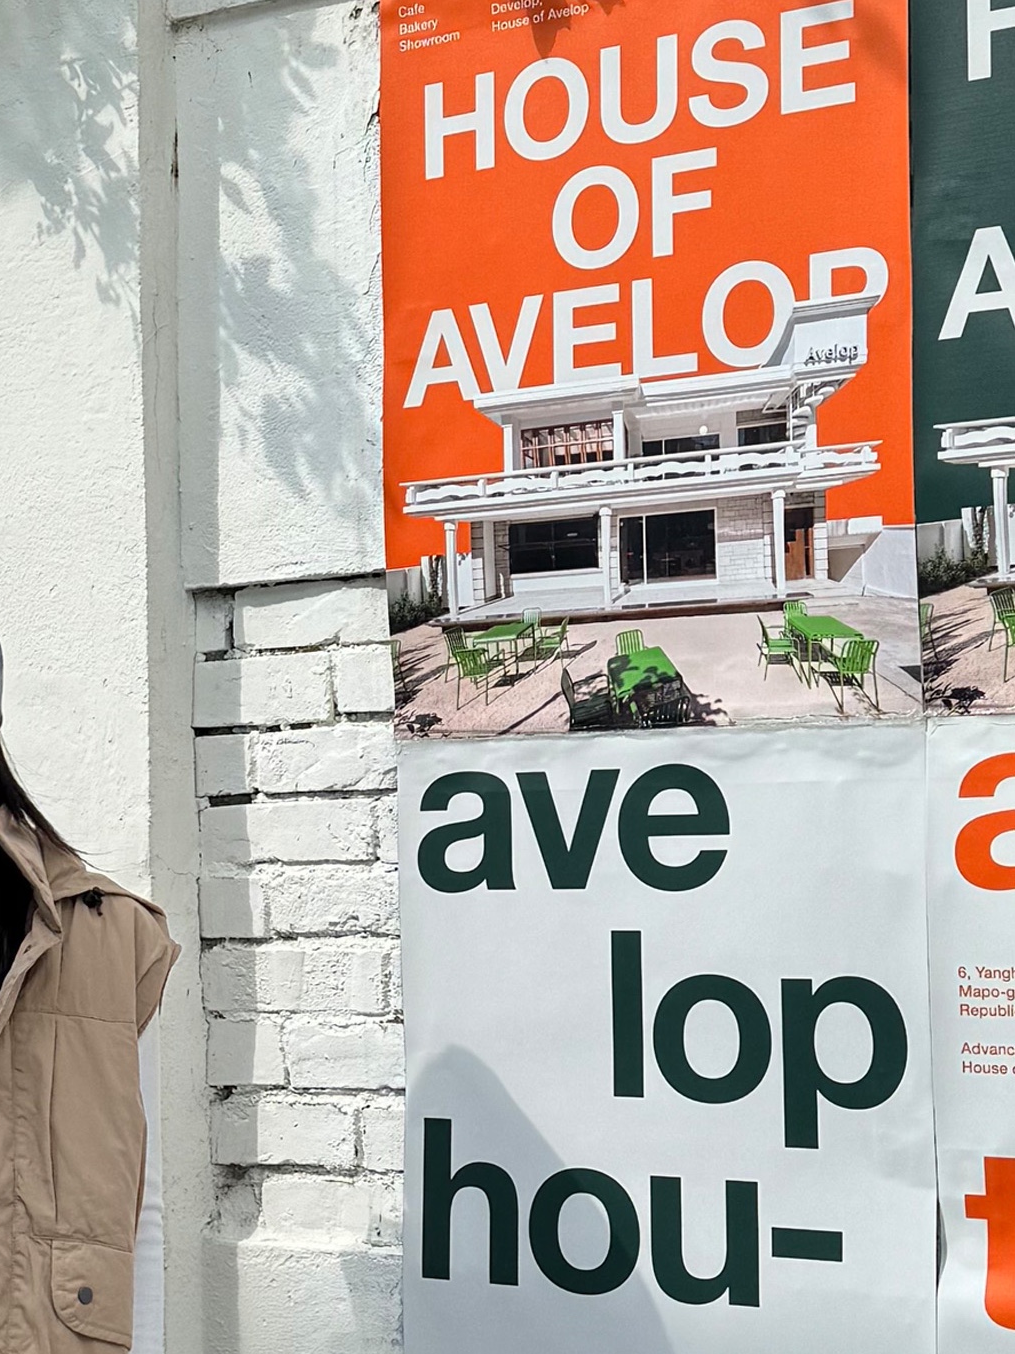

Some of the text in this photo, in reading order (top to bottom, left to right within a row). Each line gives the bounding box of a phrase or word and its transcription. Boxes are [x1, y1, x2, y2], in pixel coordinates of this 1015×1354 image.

[398, 3, 425, 18] Cafe
[491, 4, 590, 32] House of Avelop
[399, 18, 438, 35] Bakery
[399, 30, 460, 52] Showroom
[424, 0, 857, 180] HOUSE
[551, 147, 718, 270] OF
[804, 343, 859, 366] Avelop
[417, 763, 730, 893] ave
[957, 966, 971, 980] 6,
[611, 930, 908, 1150] lop
[962, 1060, 1008, 1075] House
[422, 1117, 844, 1308] hou-
